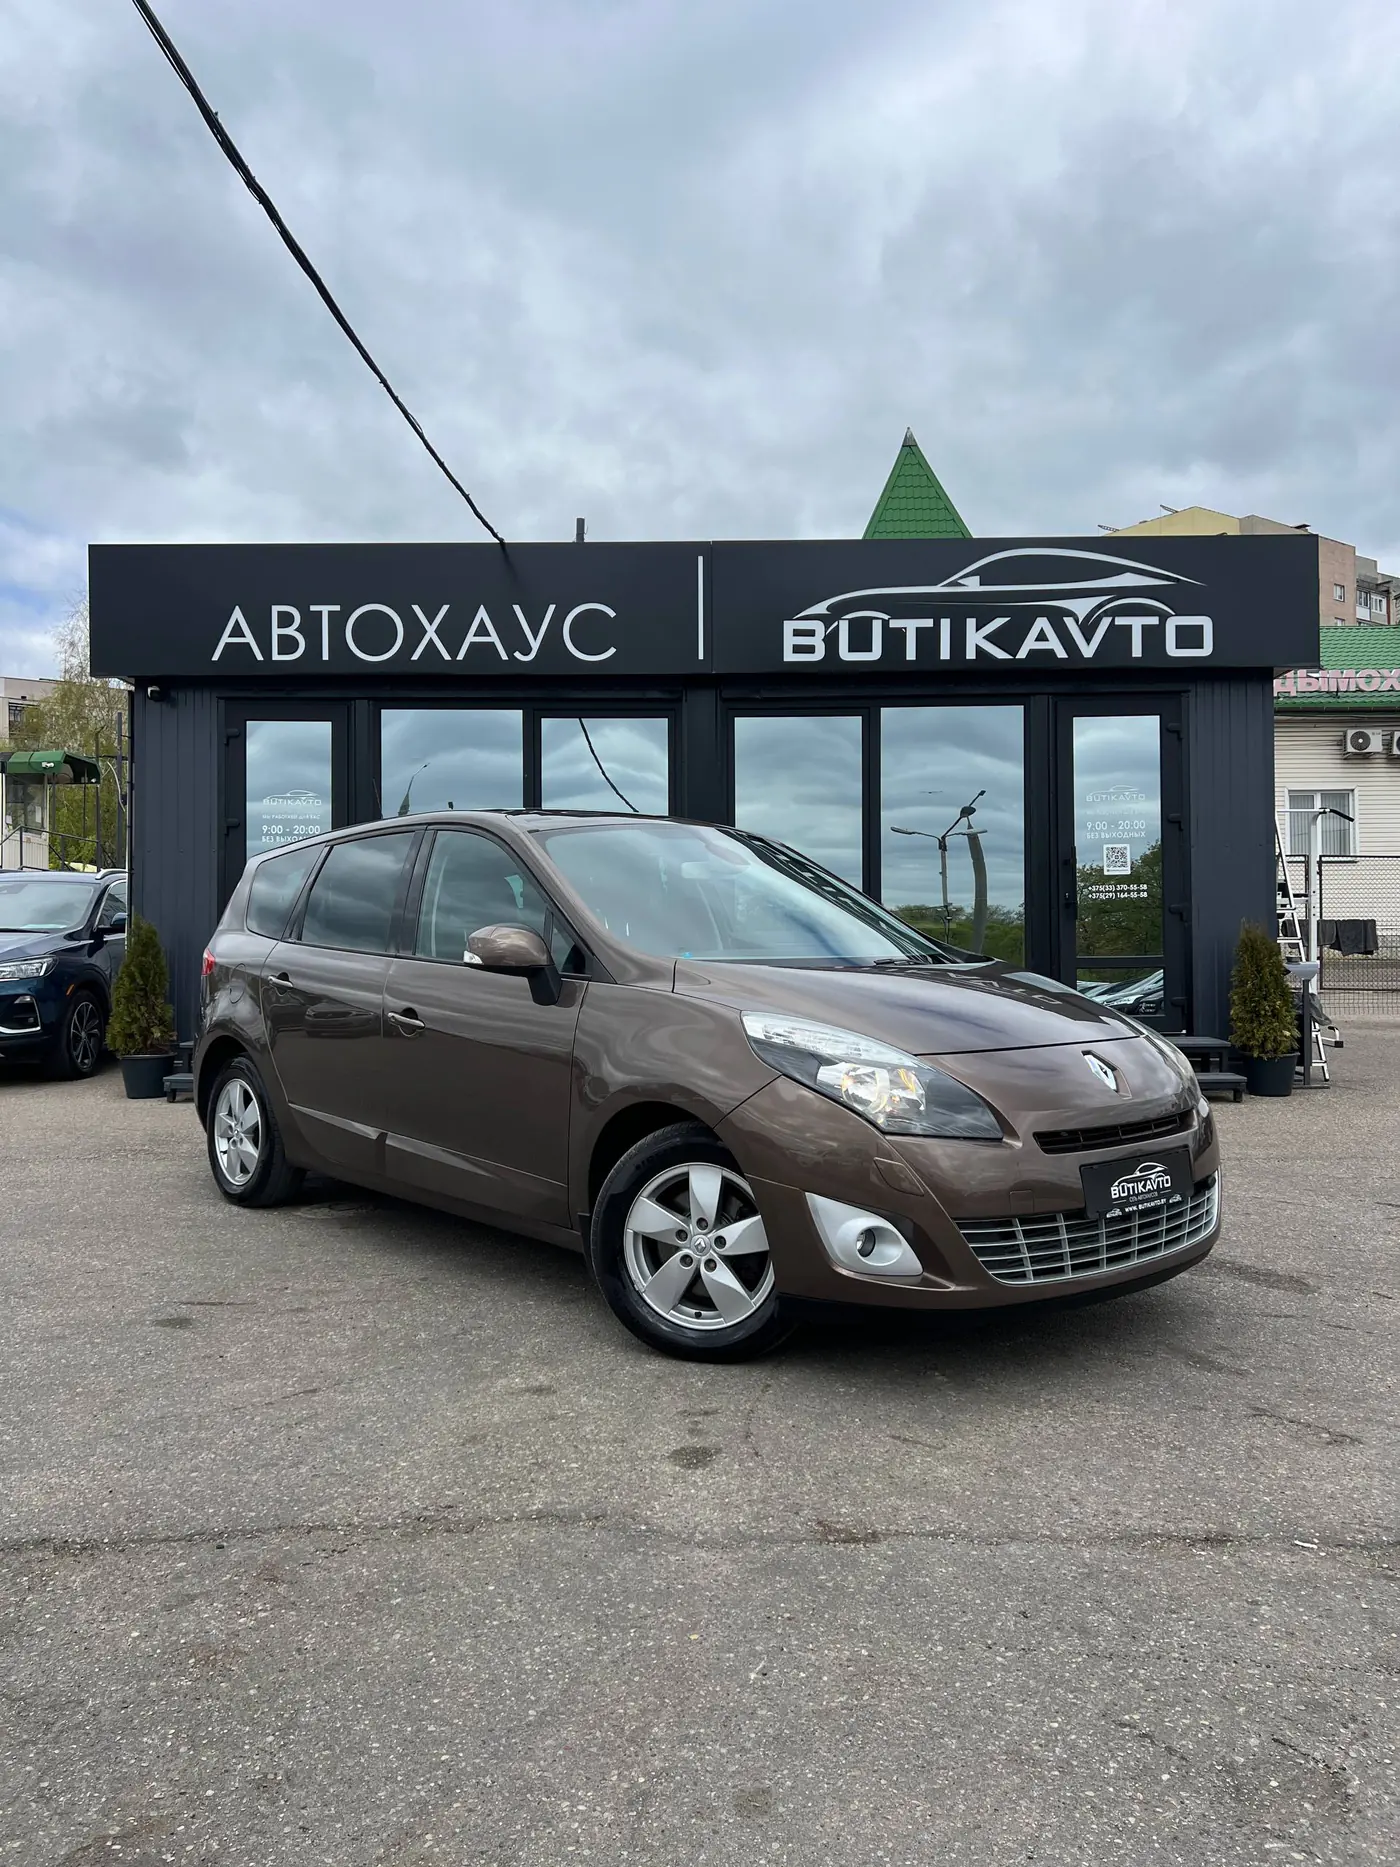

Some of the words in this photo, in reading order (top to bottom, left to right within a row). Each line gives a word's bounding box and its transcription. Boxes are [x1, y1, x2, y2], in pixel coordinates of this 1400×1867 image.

[211, 602, 617, 662] АВТОХАУС
[782, 614, 1214, 662] BUTIKAVTO
[262, 798, 322, 806] BUTIKAVTO
[1086, 793, 1146, 802] BUTIKAVTO
[262, 825, 283, 834] 9:00
[293, 825, 320, 834] 20:00
[1086, 821, 1108, 831] 9:00
[1118, 820, 1146, 829] 20:00
[261, 835, 275, 843] БЕЗ
[1086, 832, 1099, 840] БЕЗ
[1100, 830, 1147, 839] ВЫХОДНЫХ
[1088, 884, 1116, 892] +375(33)
[1116, 883, 1148, 891] 370-55-58
[1088, 891, 1116, 900] +375(29)
[1117, 891, 1148, 899] 164-55-58
[1111, 1175, 1171, 1198] BUTIKAVTO
